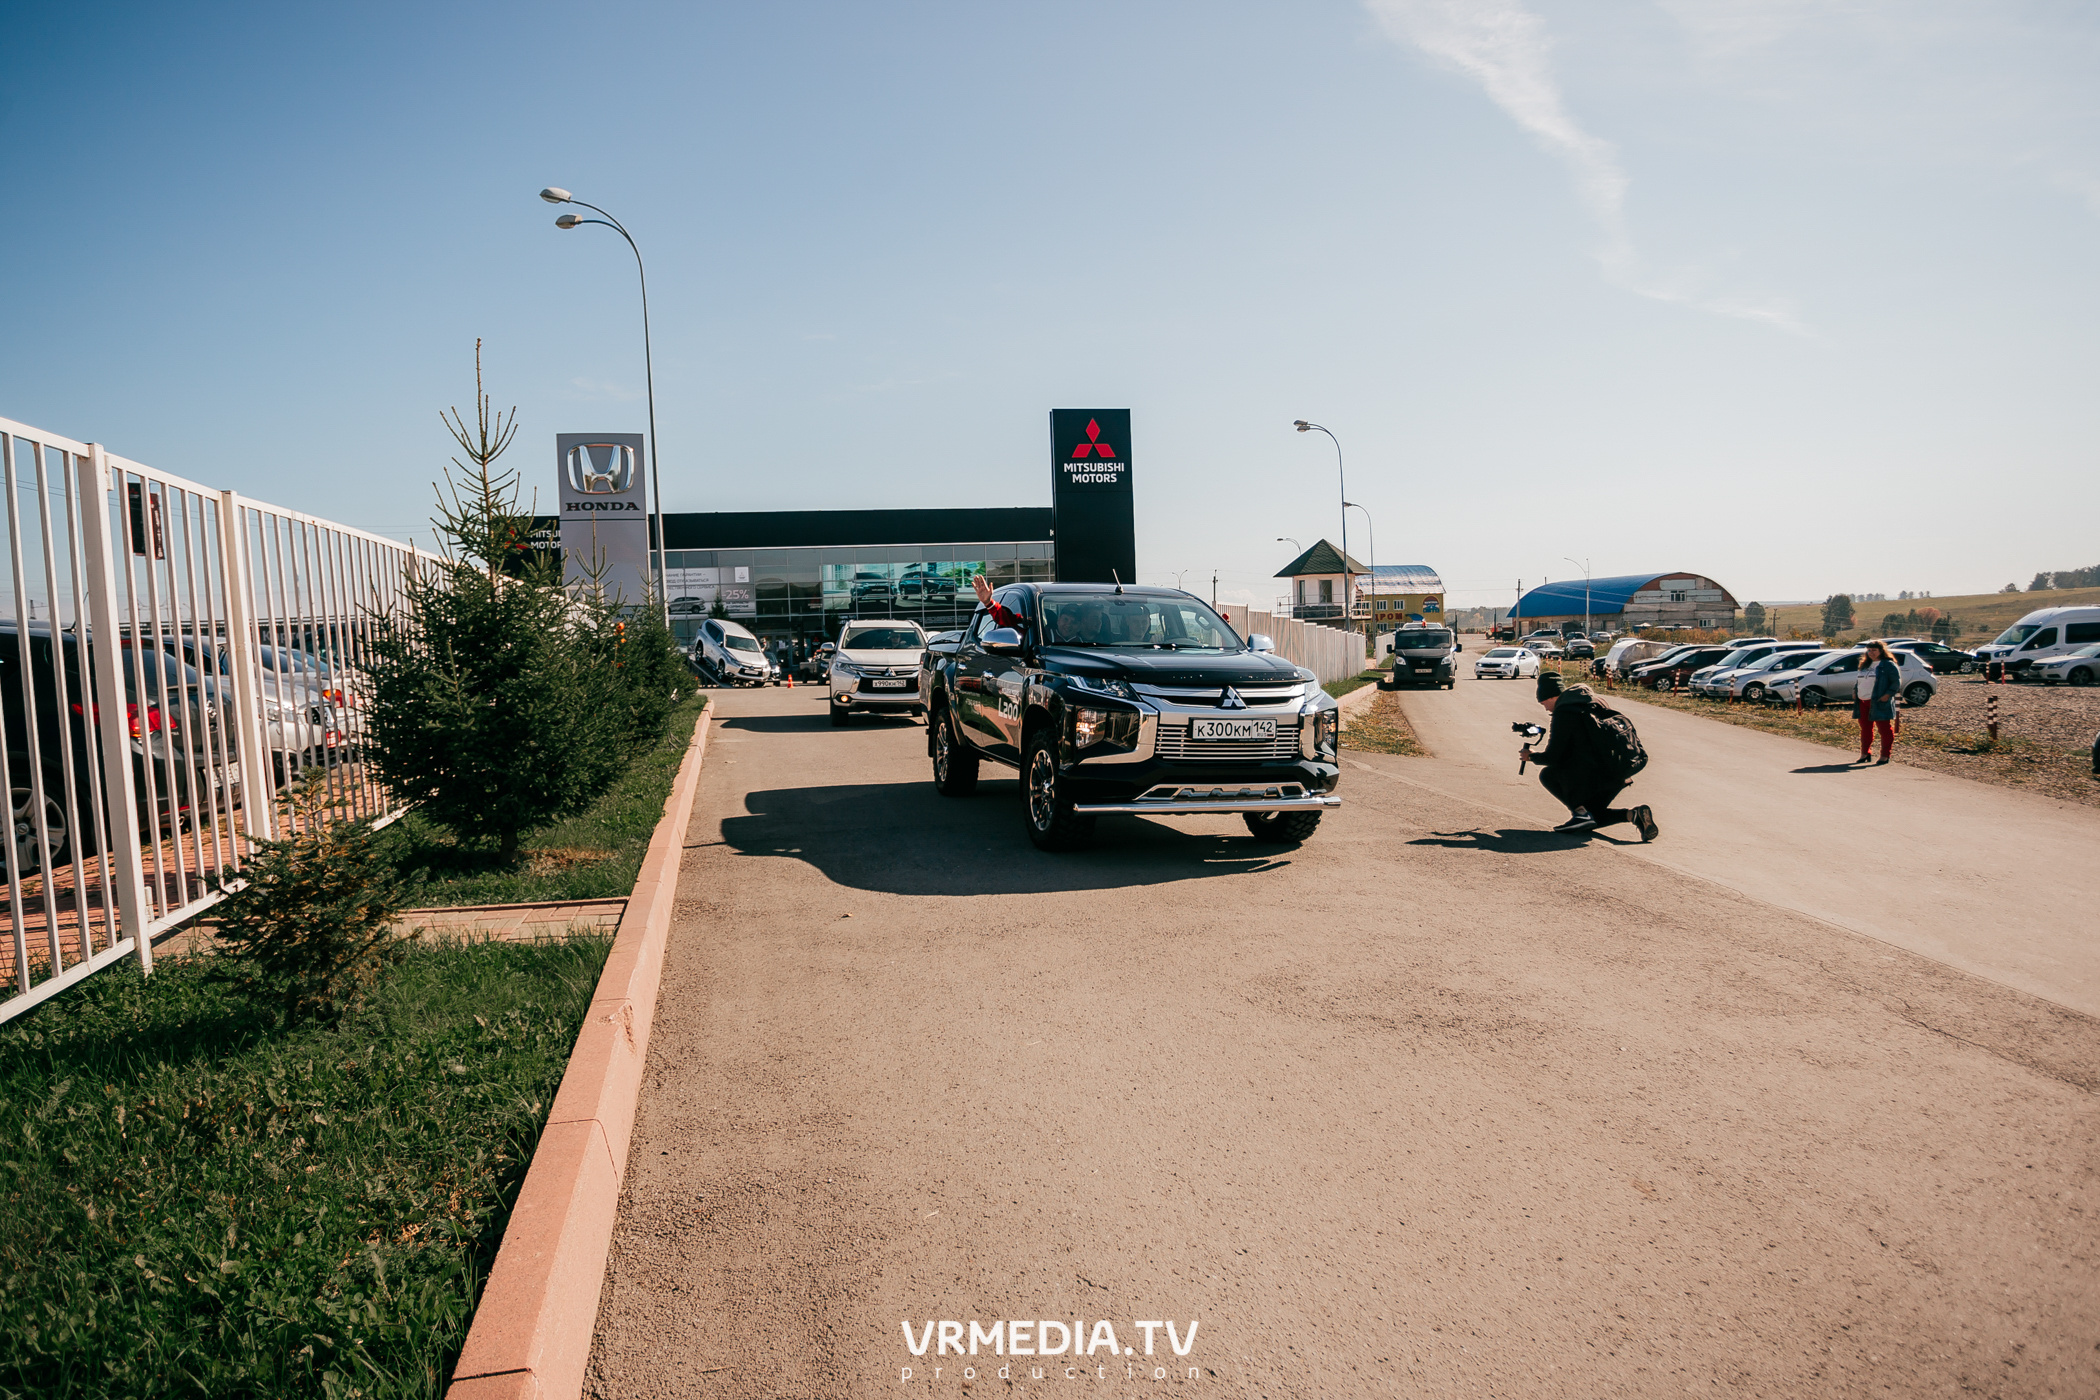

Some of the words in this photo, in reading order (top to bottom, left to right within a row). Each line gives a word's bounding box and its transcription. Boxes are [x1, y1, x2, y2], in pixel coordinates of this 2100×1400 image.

[1063, 463, 1125, 472] MITSUBISHI
[1072, 473, 1118, 483] MOTORS
[565, 501, 640, 511] HONDA
[998, 697, 1019, 722] L200
[1253, 721, 1273, 733] 142
